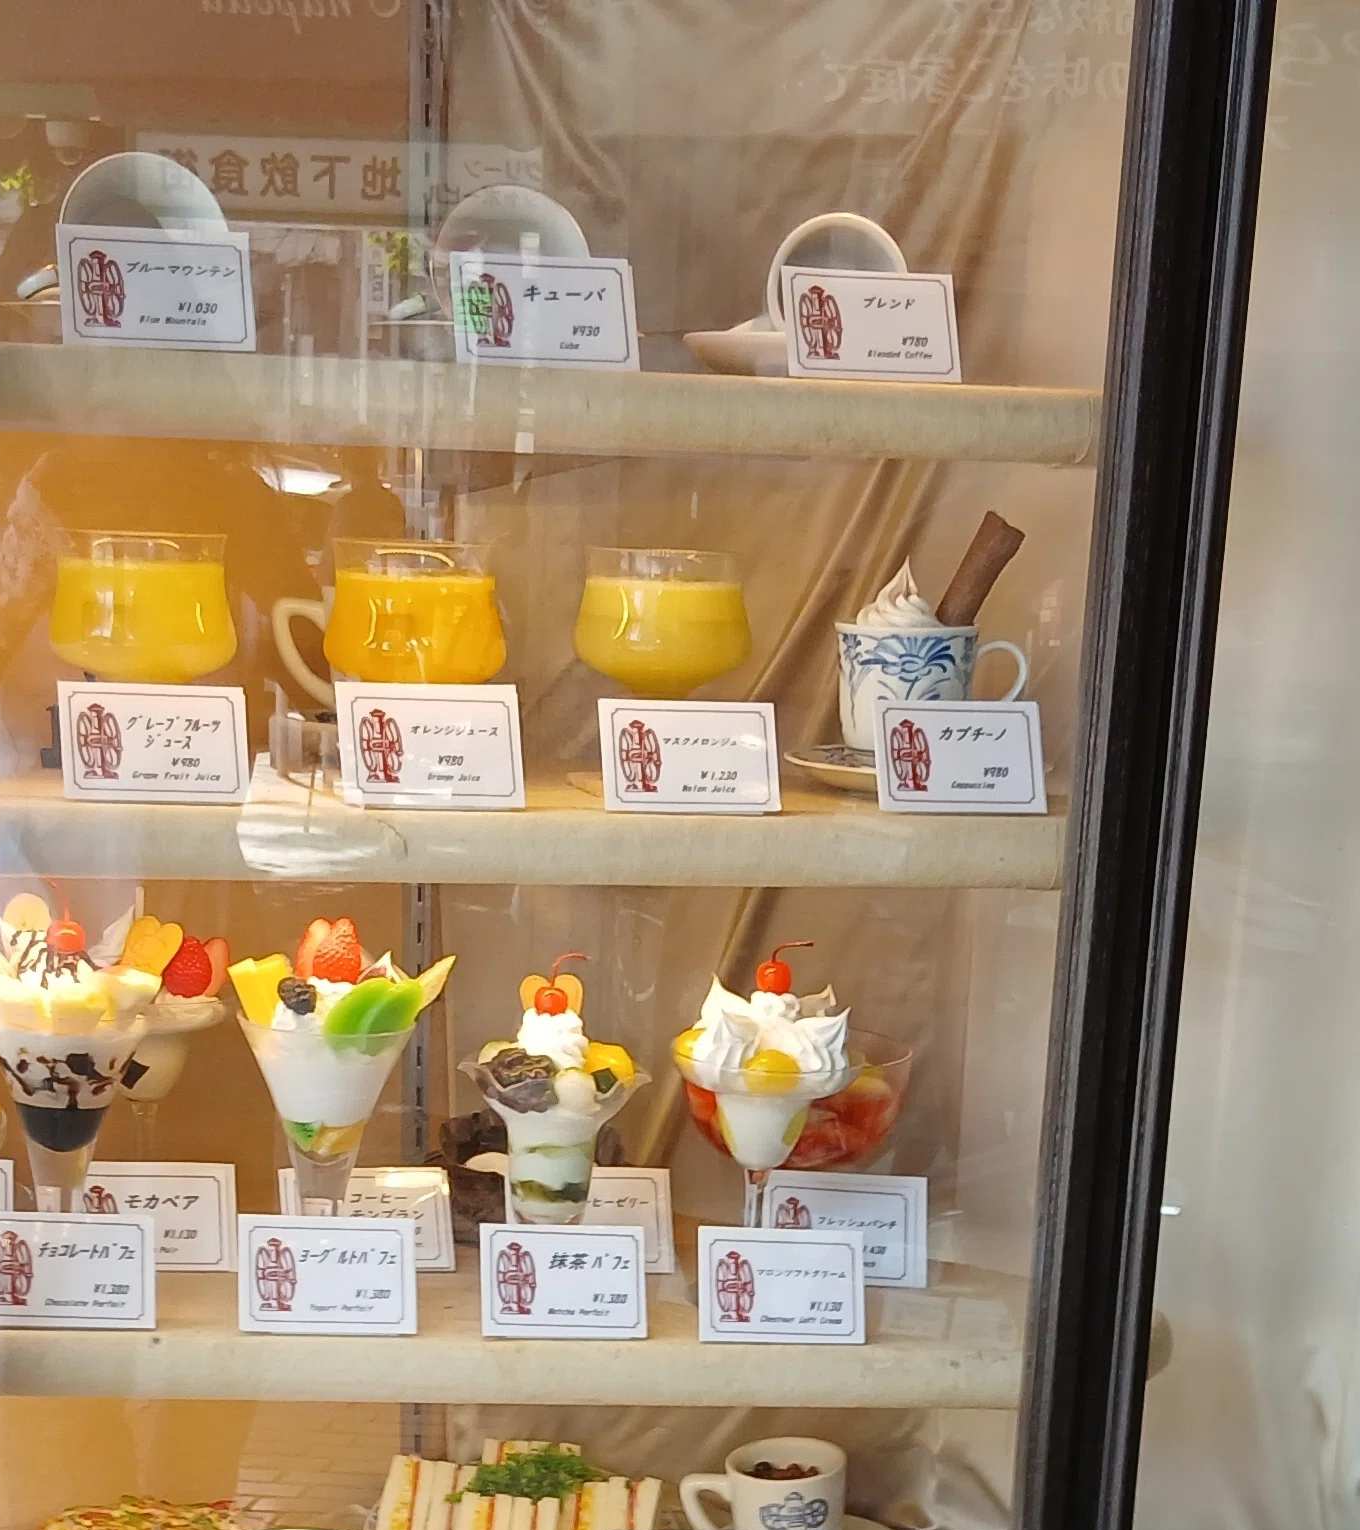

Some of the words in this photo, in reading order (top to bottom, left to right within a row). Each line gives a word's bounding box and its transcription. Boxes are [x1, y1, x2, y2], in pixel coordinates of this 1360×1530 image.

[126, 262, 236, 277] ブルーマウンテン
[523, 284, 606, 302] キューバ
[864, 296, 915, 310] ブレンド
[572, 325, 600, 336] ¥930
[902, 337, 928, 347] ¥780
[868, 350, 901, 359] Blended
[905, 351, 933, 360] Coffee
[410, 725, 499, 737] オレンジジュース
[939, 726, 1007, 742] カプチーノ
[145, 733, 192, 749] ジュース
[438, 755, 464, 766] ¥980
[427, 773, 454, 781] Orange
[350, 1193, 408, 1204] コーヒー
